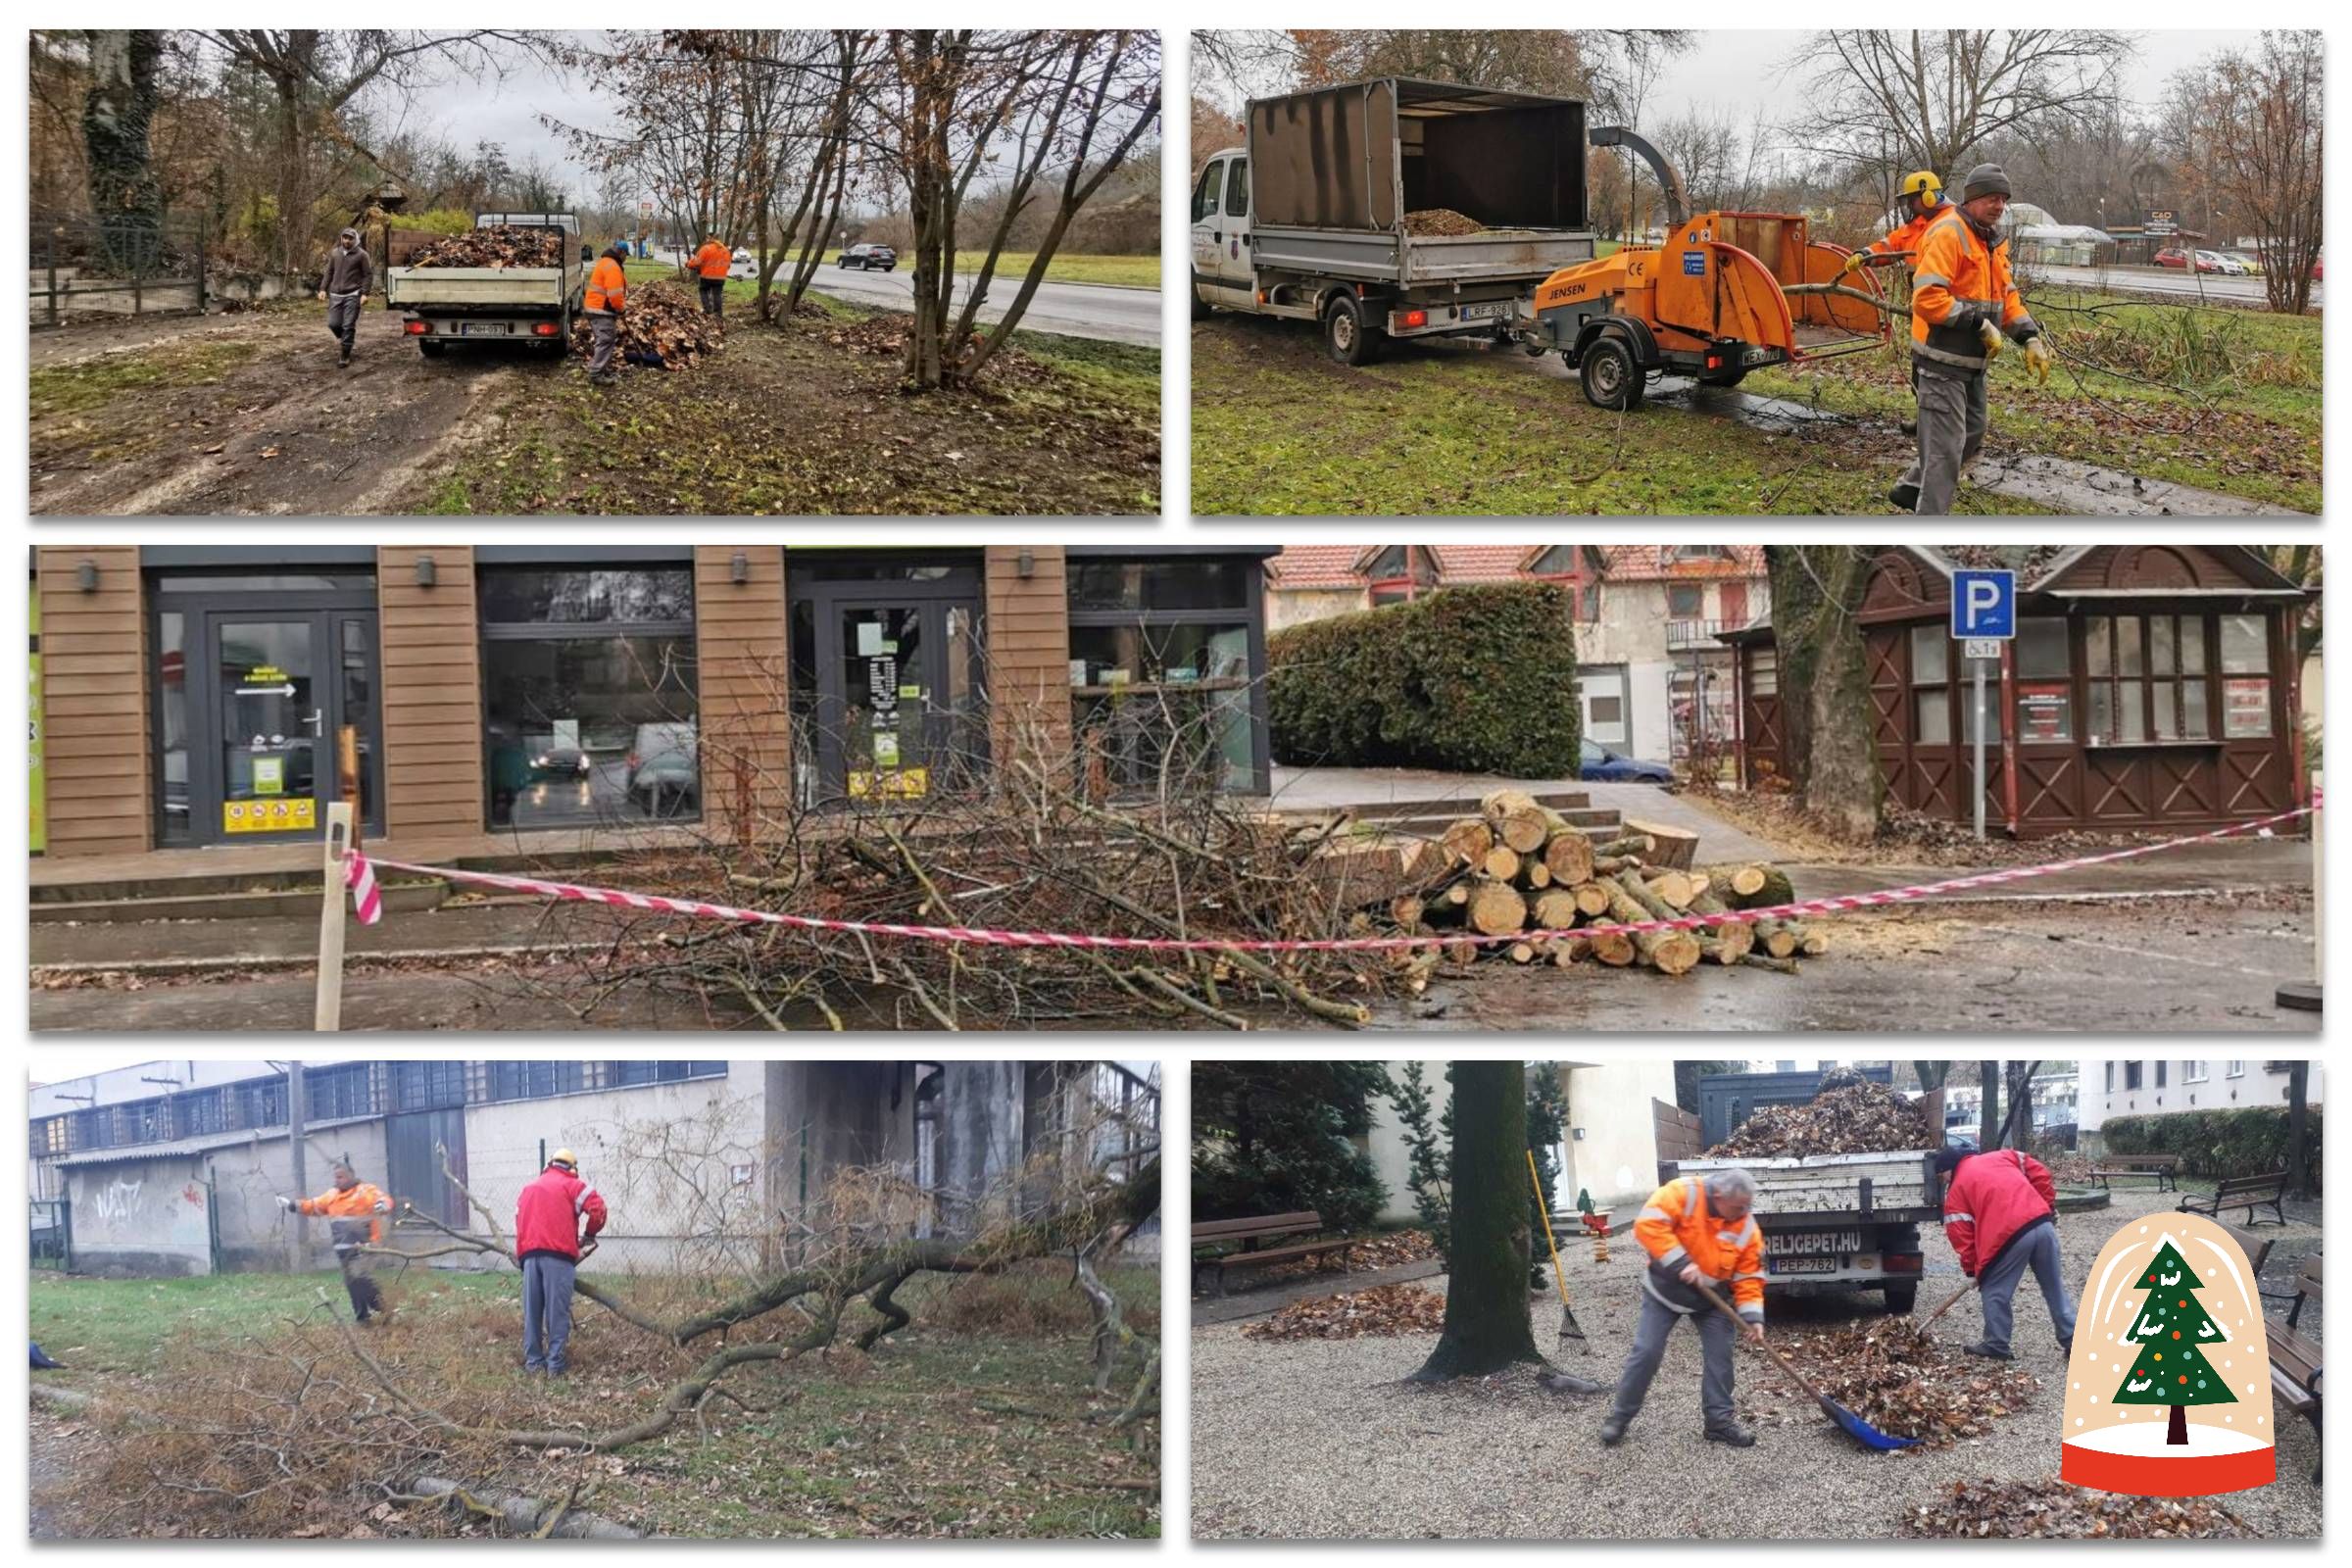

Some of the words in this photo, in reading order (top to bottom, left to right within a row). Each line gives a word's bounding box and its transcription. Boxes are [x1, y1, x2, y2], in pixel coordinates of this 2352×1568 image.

[1548, 282, 1587, 300] JENSEN
[1467, 304, 1508, 318] LRF-926
[1966, 579, 2000, 629] P
[1764, 1231, 1862, 1254] RELJGEPET.HU
[1779, 1258, 1833, 1271] PEP-762
